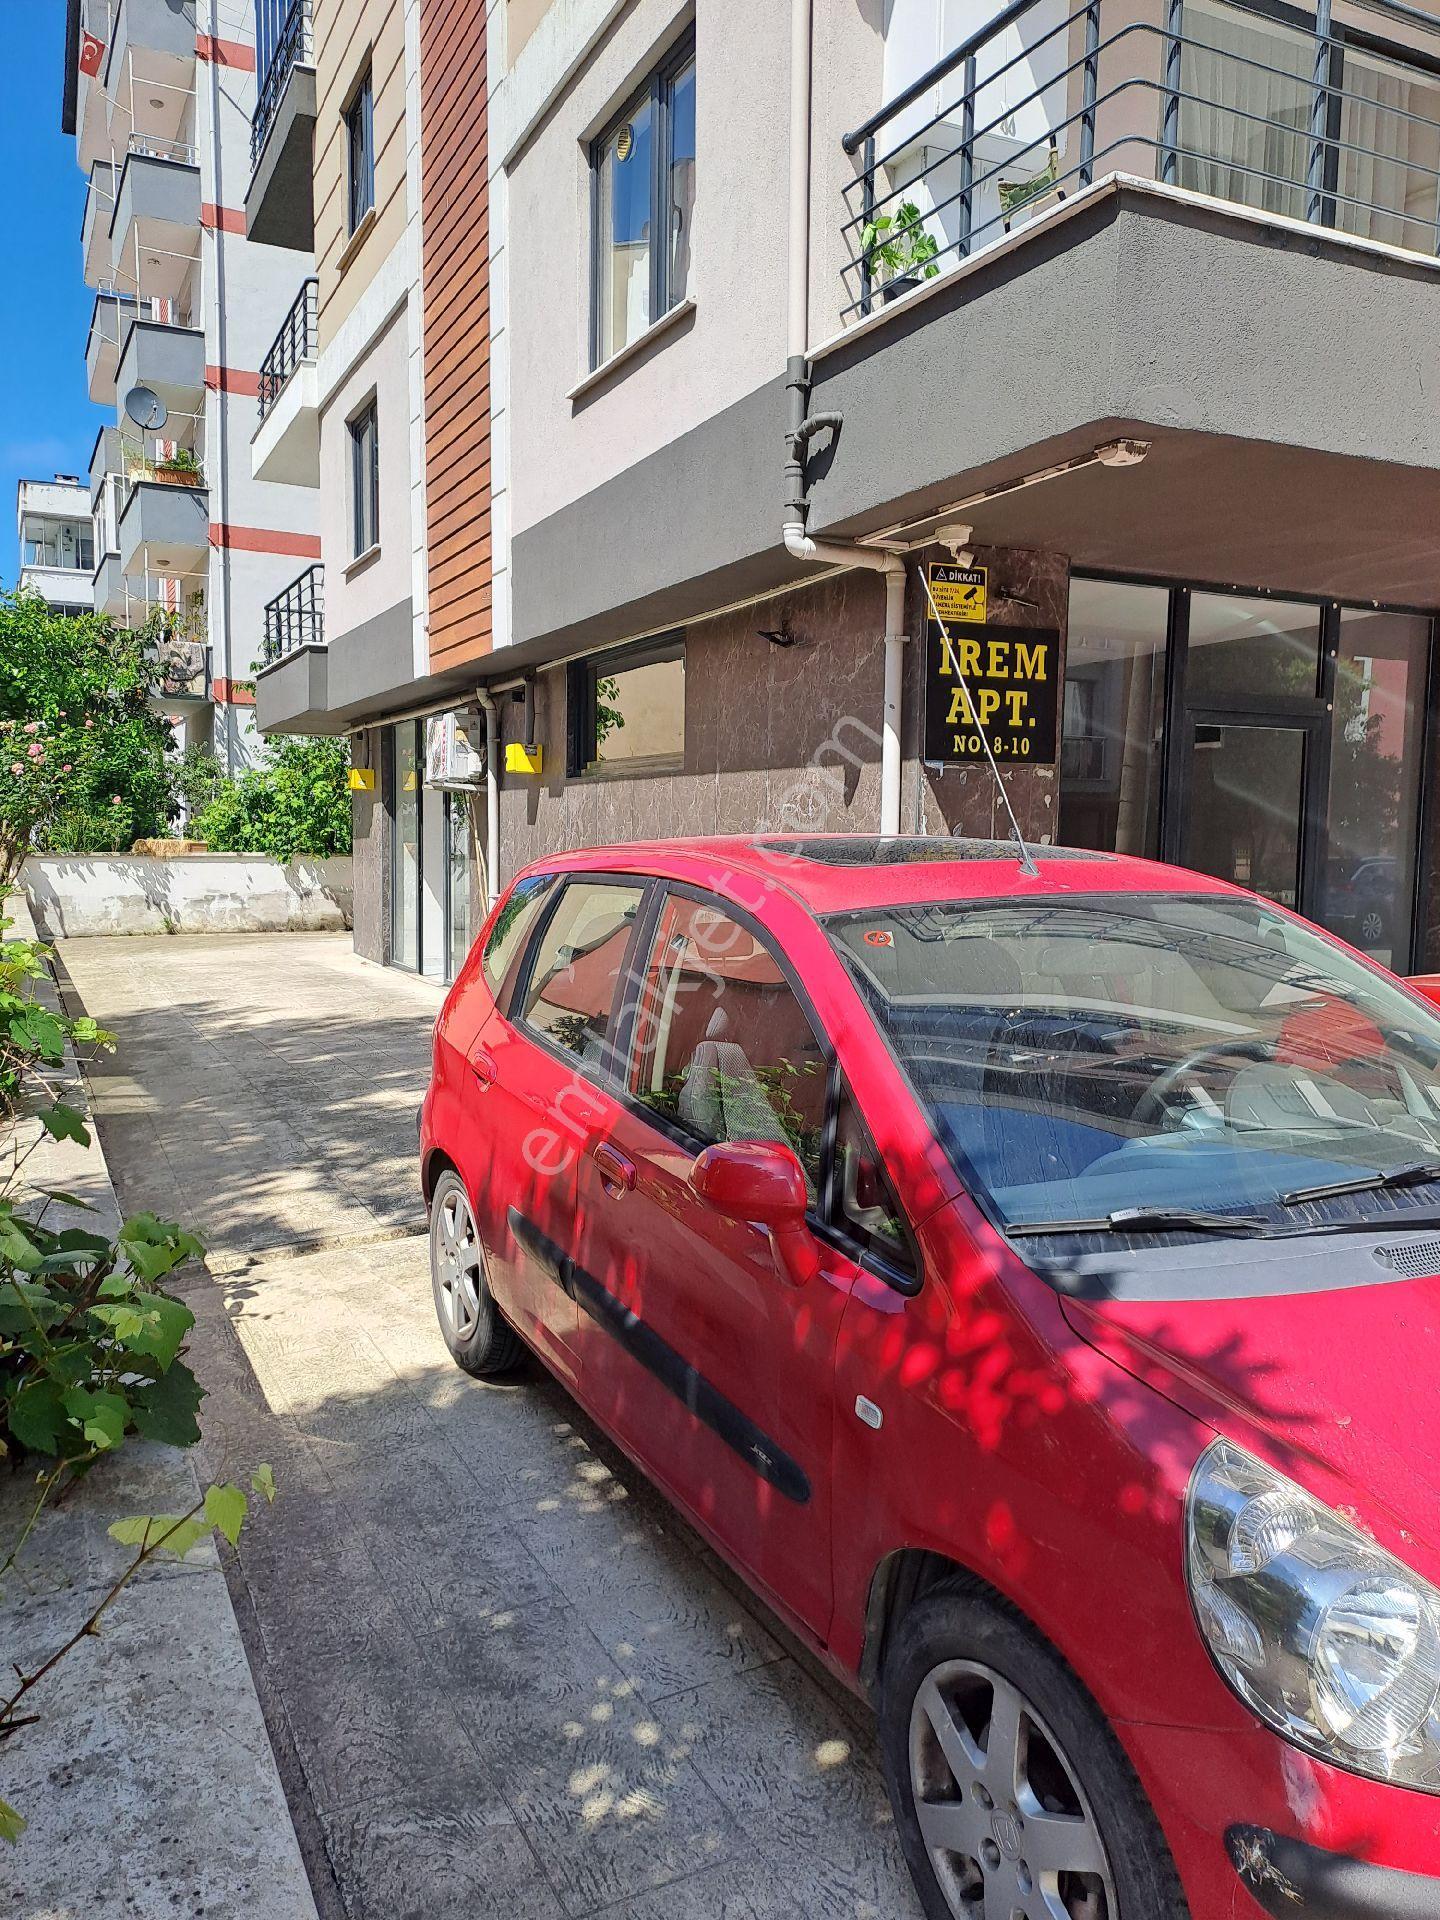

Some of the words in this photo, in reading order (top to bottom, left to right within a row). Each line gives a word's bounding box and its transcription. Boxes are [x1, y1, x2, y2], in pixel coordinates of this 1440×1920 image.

[949, 570, 981, 583] DİKKAT!
[938, 627, 1047, 680] İREM
[945, 687, 1036, 727] APT.
[993, 736, 1030, 755] 8-10
